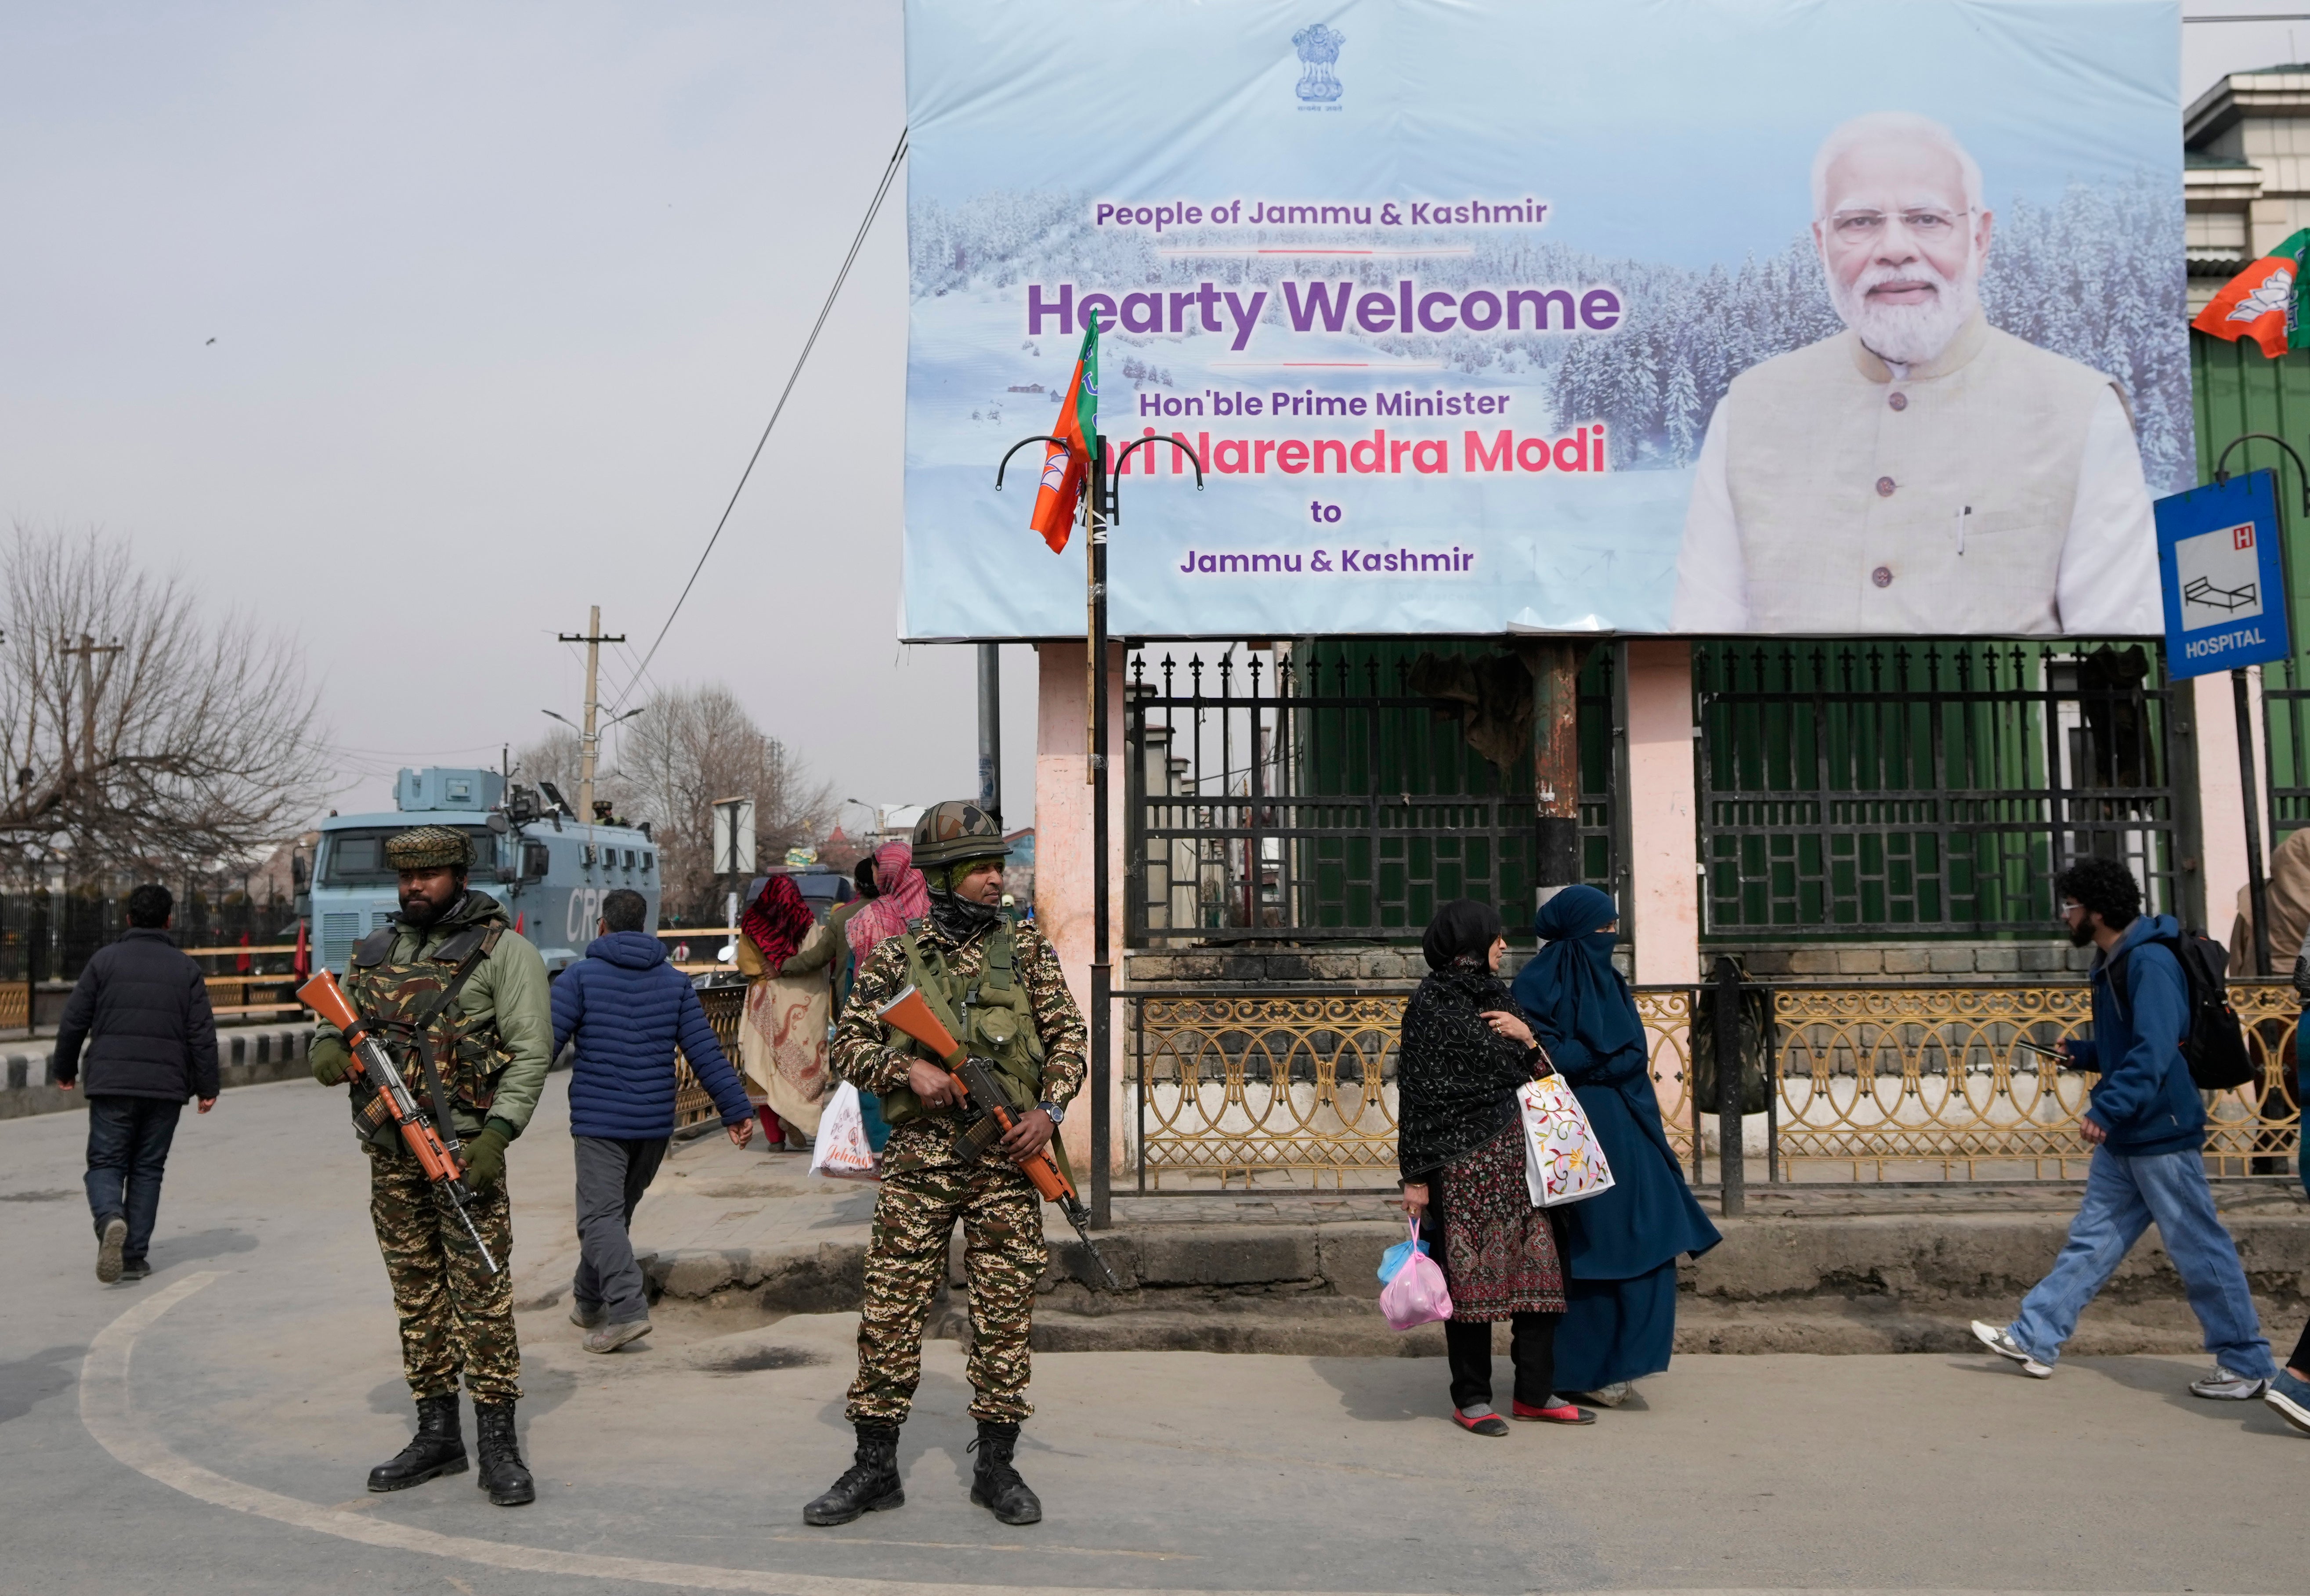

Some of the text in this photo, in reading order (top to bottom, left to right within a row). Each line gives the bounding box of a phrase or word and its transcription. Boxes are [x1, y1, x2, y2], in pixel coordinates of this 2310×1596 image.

[1097, 199, 1547, 232] People of Jammu & Kashmir
[1028, 280, 1620, 350] Hearty Welcome
[1140, 389, 1510, 416] Hon'ble Prime Minister
[1171, 428, 1448, 474] Narendra
[1464, 424, 1605, 473] Modi
[1311, 501, 1342, 523] to
[2235, 527, 2252, 549] H
[1180, 546, 1474, 573] Jammu & Kashmir
[2185, 627, 2266, 659] HOSPITAL
